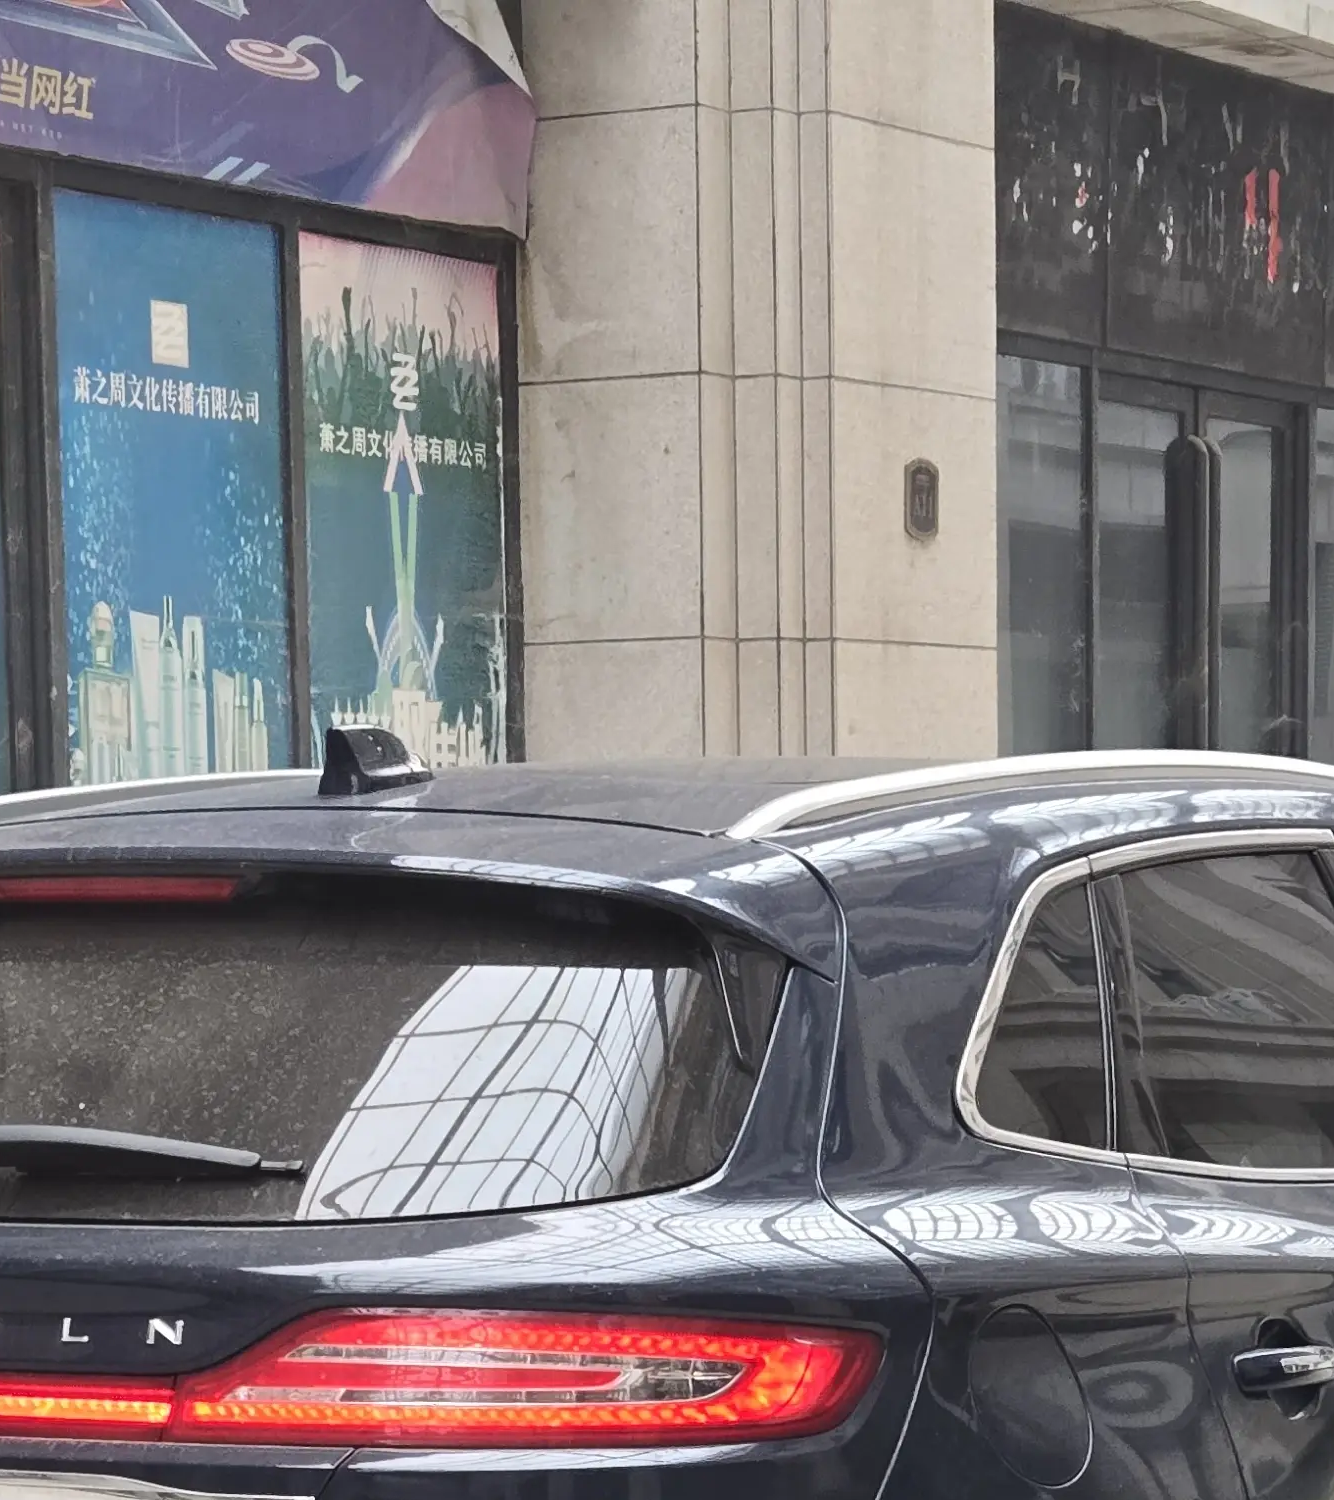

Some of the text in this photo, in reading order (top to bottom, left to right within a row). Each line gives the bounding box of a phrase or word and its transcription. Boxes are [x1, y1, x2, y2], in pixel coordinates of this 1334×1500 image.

[73, 366, 260, 426] 萧之周文化传播有限公司
